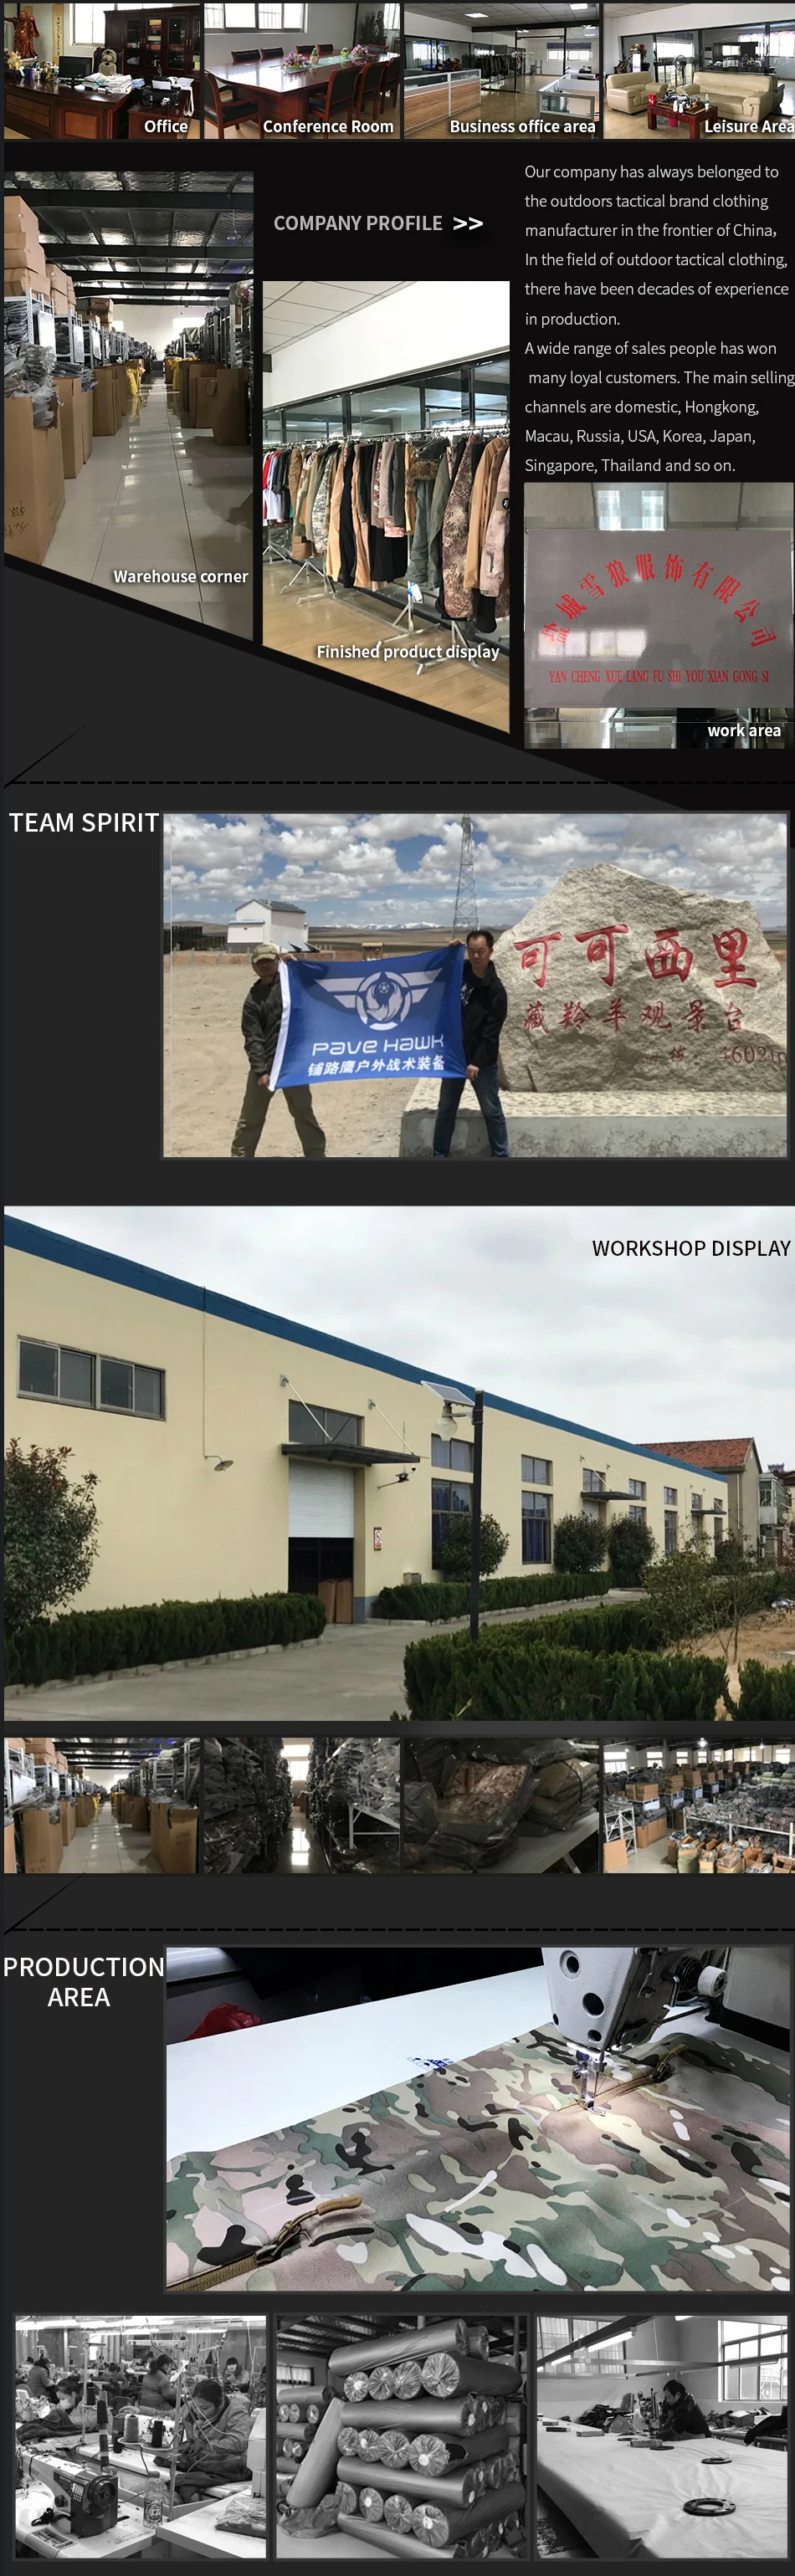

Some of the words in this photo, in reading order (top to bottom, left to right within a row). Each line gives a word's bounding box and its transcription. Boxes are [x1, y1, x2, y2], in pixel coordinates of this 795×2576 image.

[541, 552, 777, 648] 盐城雪狼服饰有限公司
[548, 670, 567, 684] YAN
[570, 669, 602, 684] CHENG
[604, 669, 623, 684] XUE
[625, 669, 649, 684] LANG
[653, 669, 664, 684] FU
[667, 669, 683, 683] SHI
[685, 669, 704, 684] YOU
[707, 670, 729, 684] XIAN
[732, 670, 758, 684] GONG
[761, 670, 770, 684] SI
[513, 923, 758, 990] 可可西里
[523, 996, 744, 1035] 藏羚羊观景台
[307, 1054, 446, 1078] 铺路鹰户外战术装备
